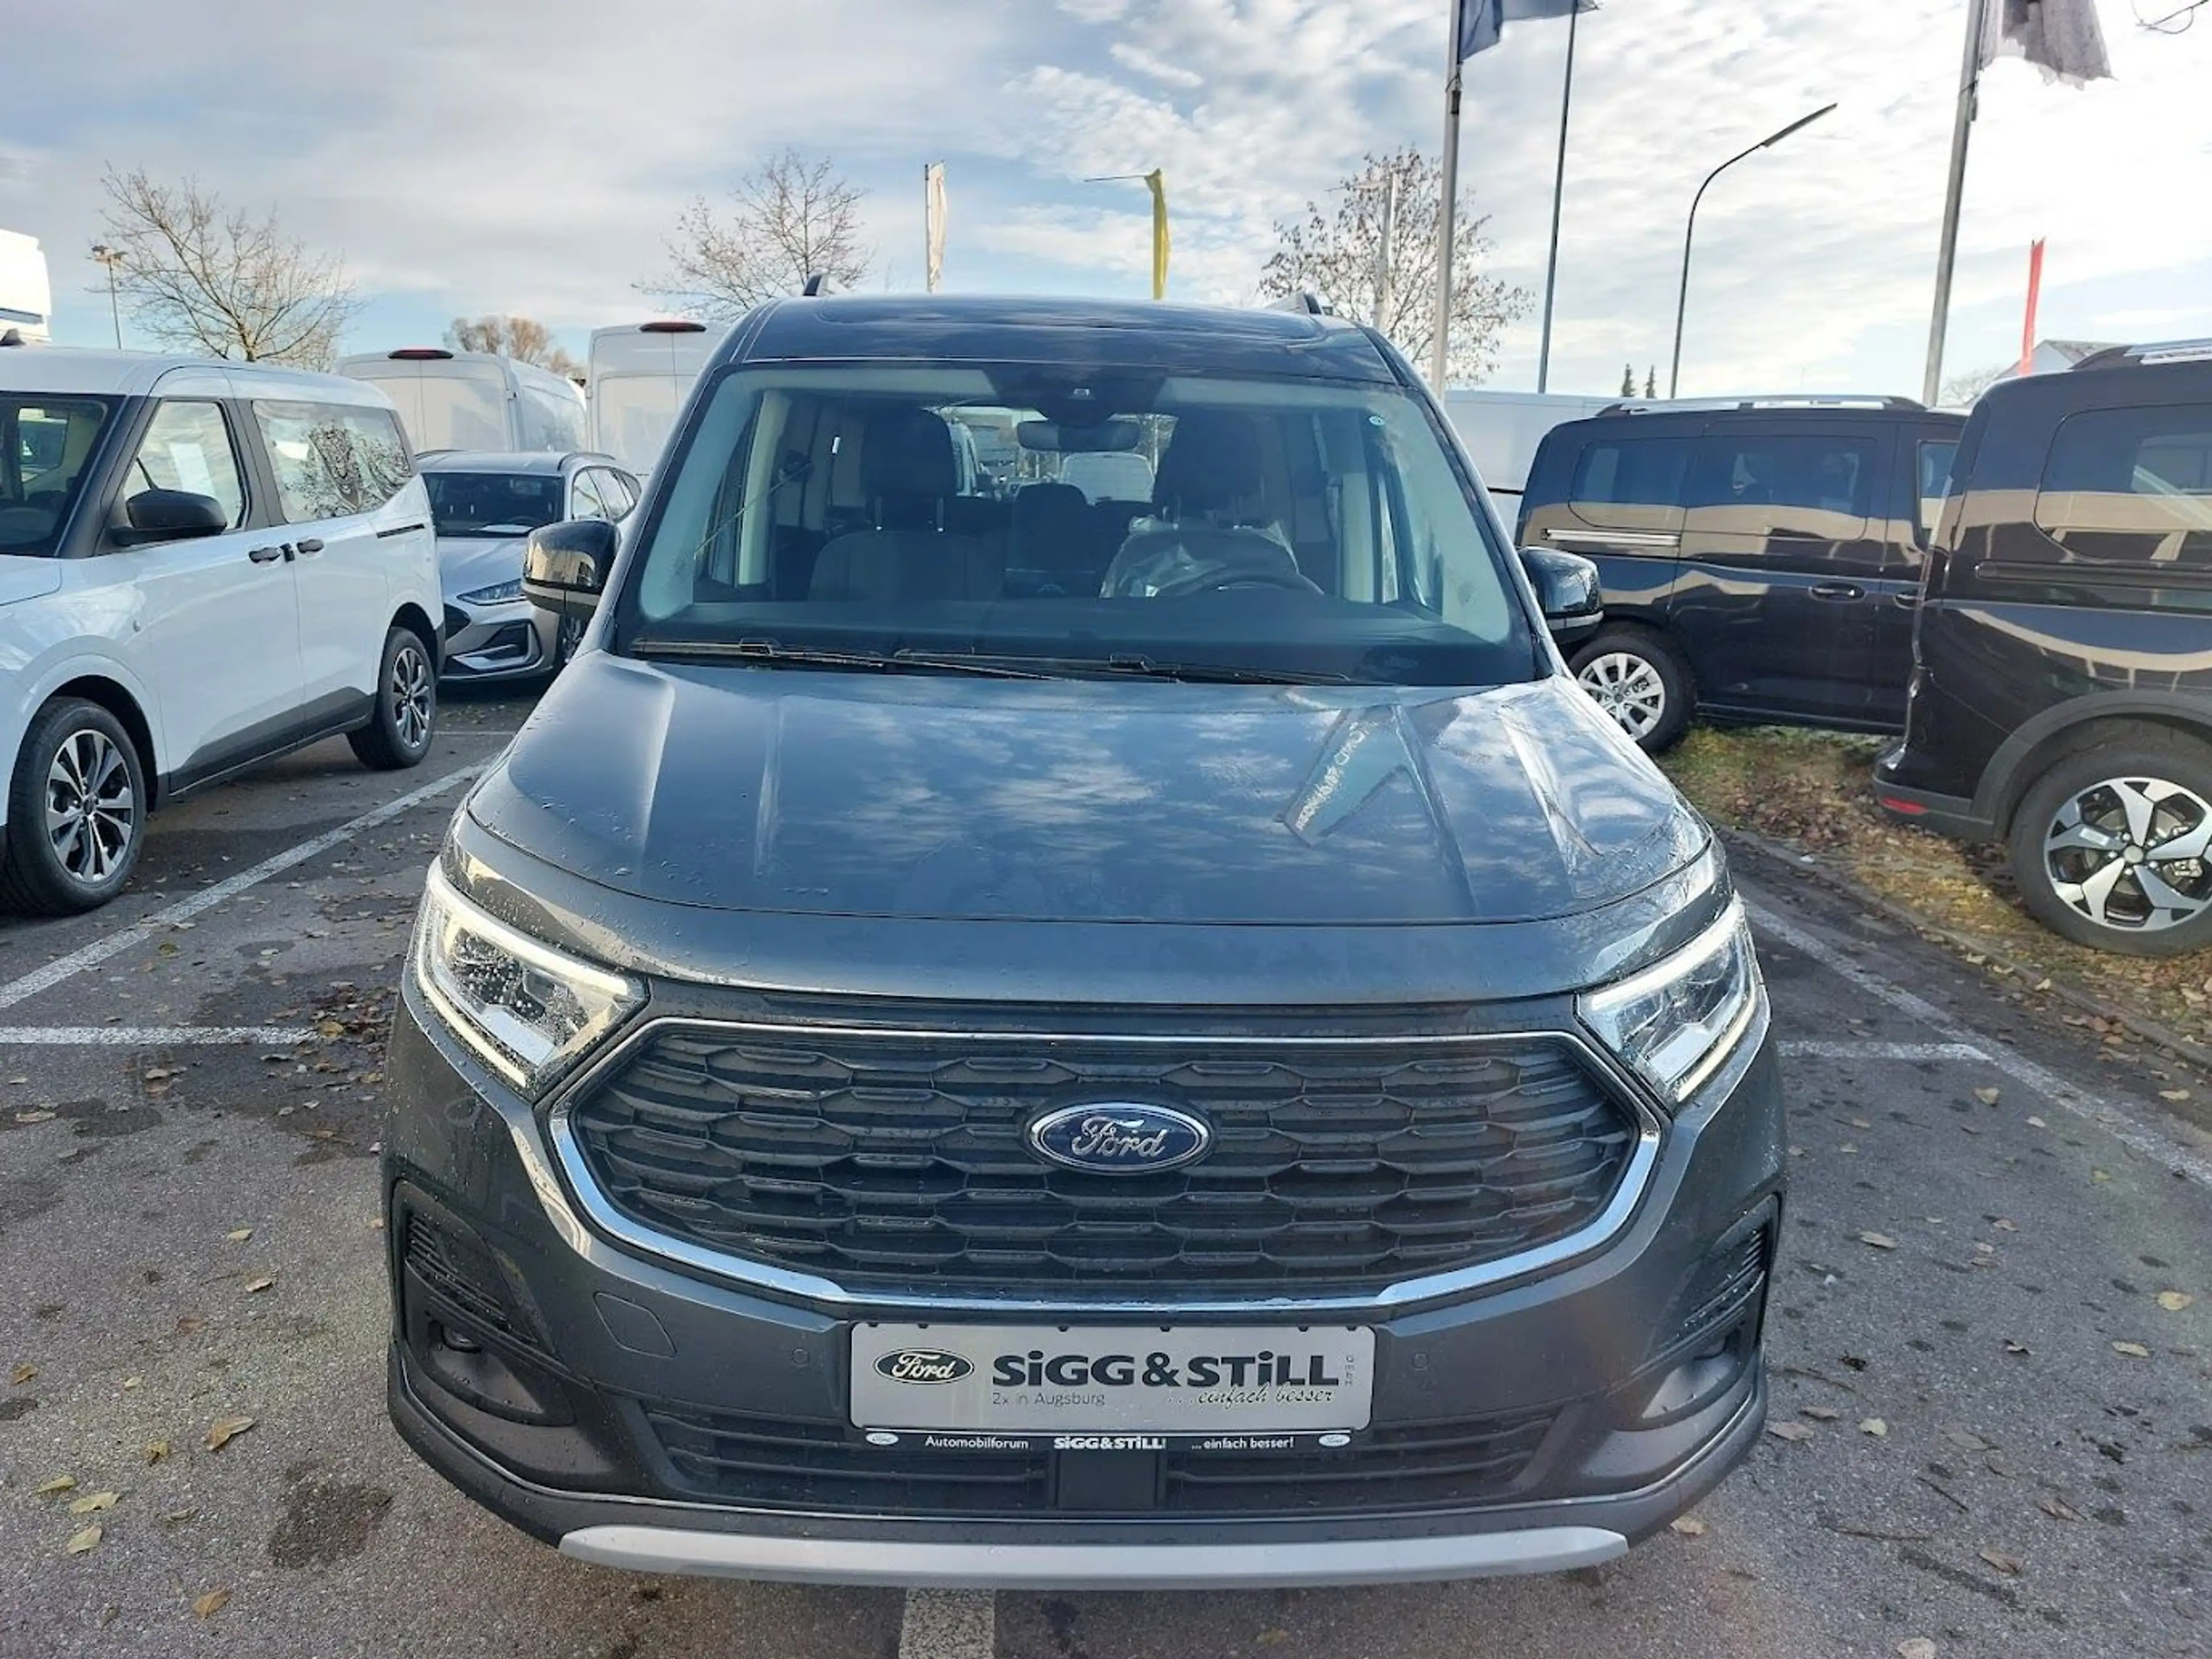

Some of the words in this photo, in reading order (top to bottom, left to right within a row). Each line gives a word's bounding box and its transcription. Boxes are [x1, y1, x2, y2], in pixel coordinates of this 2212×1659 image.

[1071, 1115, 1168, 1157] Ford
[891, 1353, 957, 1378] Ford
[992, 1392, 1009, 1405] 2x
[1034, 1392, 1105, 1407] Augsburg
[1275, 1381, 1334, 1402] besser
[925, 1435, 1029, 1449] Automobilforum
[1249, 1436, 1294, 1449] besser!
